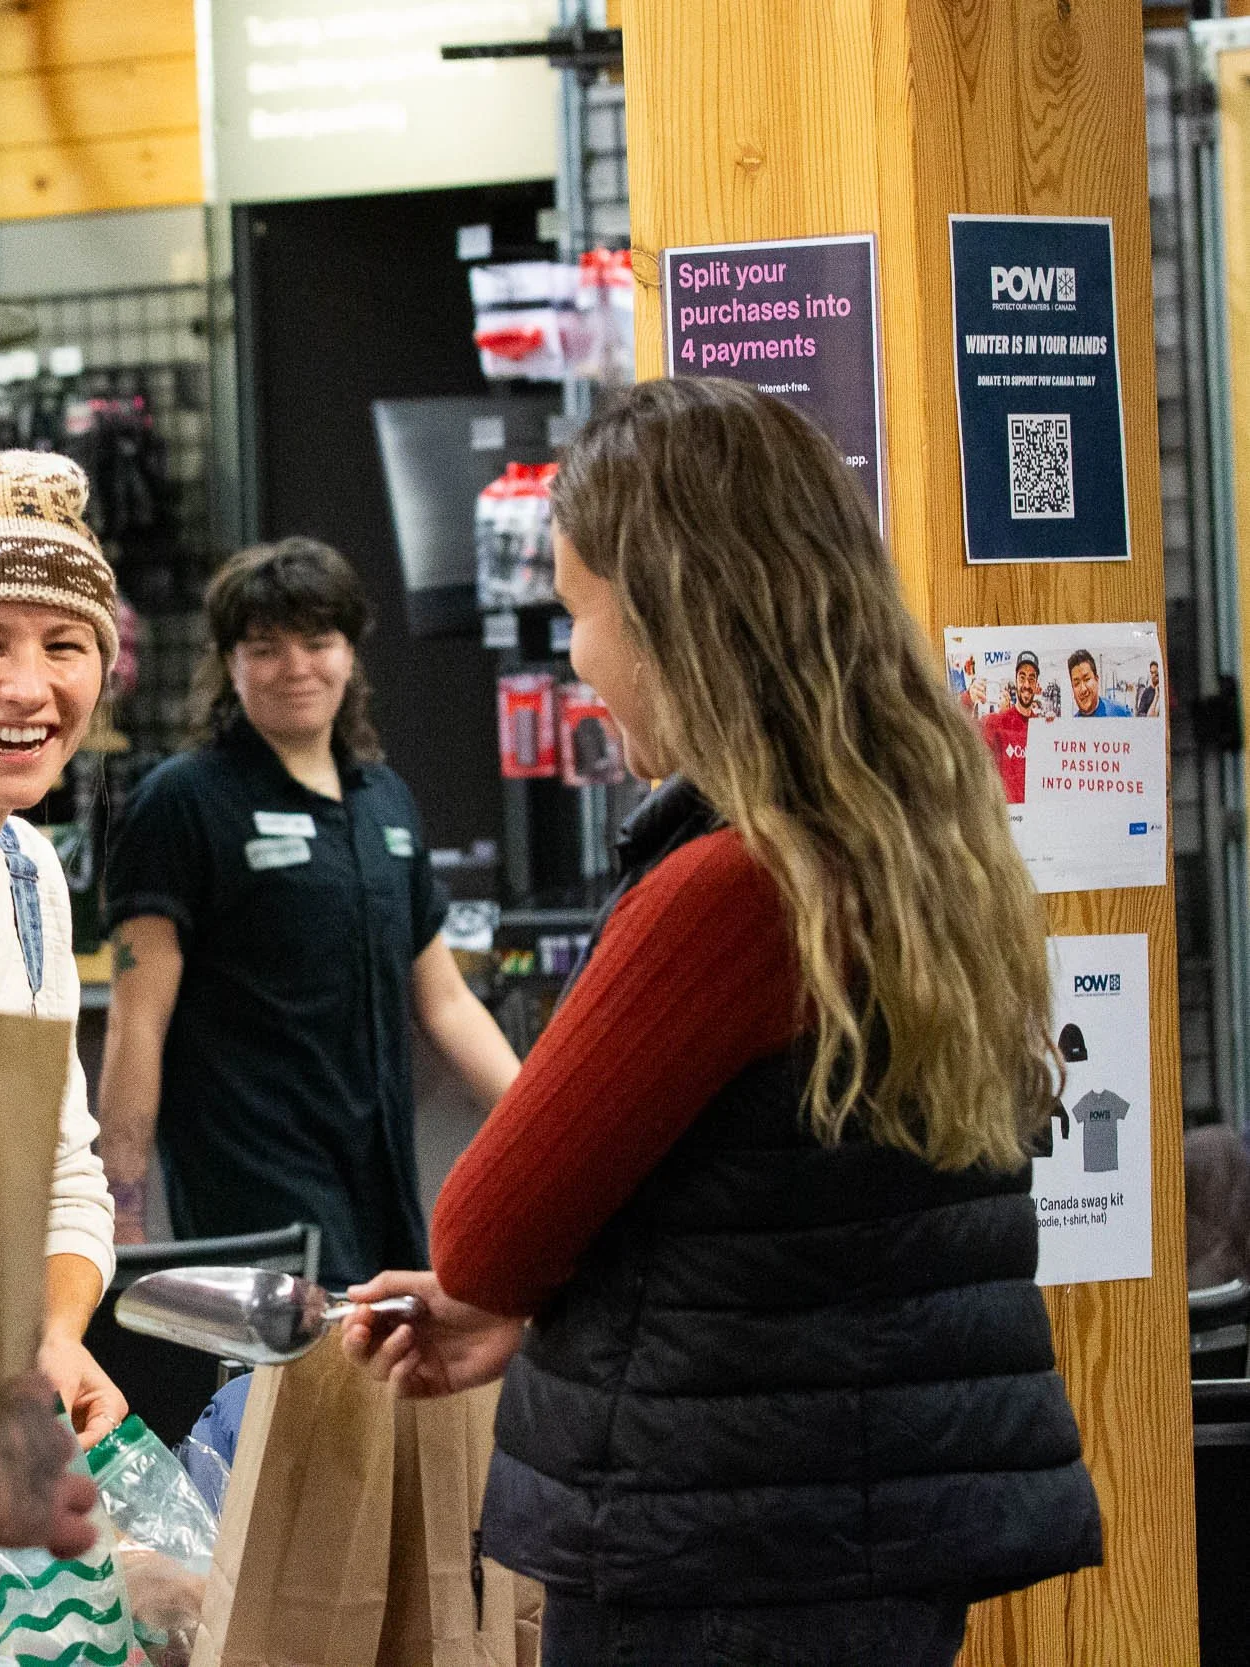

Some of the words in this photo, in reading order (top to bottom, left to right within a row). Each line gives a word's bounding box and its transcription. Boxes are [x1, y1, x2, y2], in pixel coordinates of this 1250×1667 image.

[678, 261, 731, 293] Split
[735, 263, 787, 291] your
[991, 266, 1055, 302] POW
[680, 298, 800, 332] purchases
[805, 293, 851, 318] into
[992, 303, 1015, 311] PROTECT
[1016, 303, 1027, 311] OUR
[1027, 303, 1050, 311] WINTERS
[1054, 303, 1076, 311] CANADA
[680, 338, 696, 363] 4
[701, 334, 816, 369] payments
[965, 335, 1010, 354] WINTER
[1011, 335, 1023, 354] IS
[1024, 335, 1038, 354] IN
[1039, 335, 1067, 354] YOUR
[1069, 336, 1107, 355] HANDS
[977, 375, 1002, 386] DONATE
[1002, 375, 1011, 386] TO
[1011, 375, 1038, 386] SUPPORT
[1038, 375, 1051, 386] POW
[1051, 375, 1075, 386] CANADA
[1076, 375, 1096, 386] TODAY
[845, 456, 869, 468] app.
[1053, 741, 1086, 753] TURN
[1093, 742, 1131, 754] YOUR
[1062, 759, 1120, 772] PASSION
[1042, 776, 1072, 790] INTO
[1078, 779, 1144, 794] PURPOSE
[1074, 974, 1108, 992] POW
[1040, 1195, 1079, 1211] Canada
[1081, 1196, 1108, 1210] swag
[1110, 1192, 1124, 1206] kit
[1037, 1215, 1062, 1228] oodie,
[1063, 1213, 1090, 1226] t-shirt,
[1090, 1211, 1107, 1225] hat)
